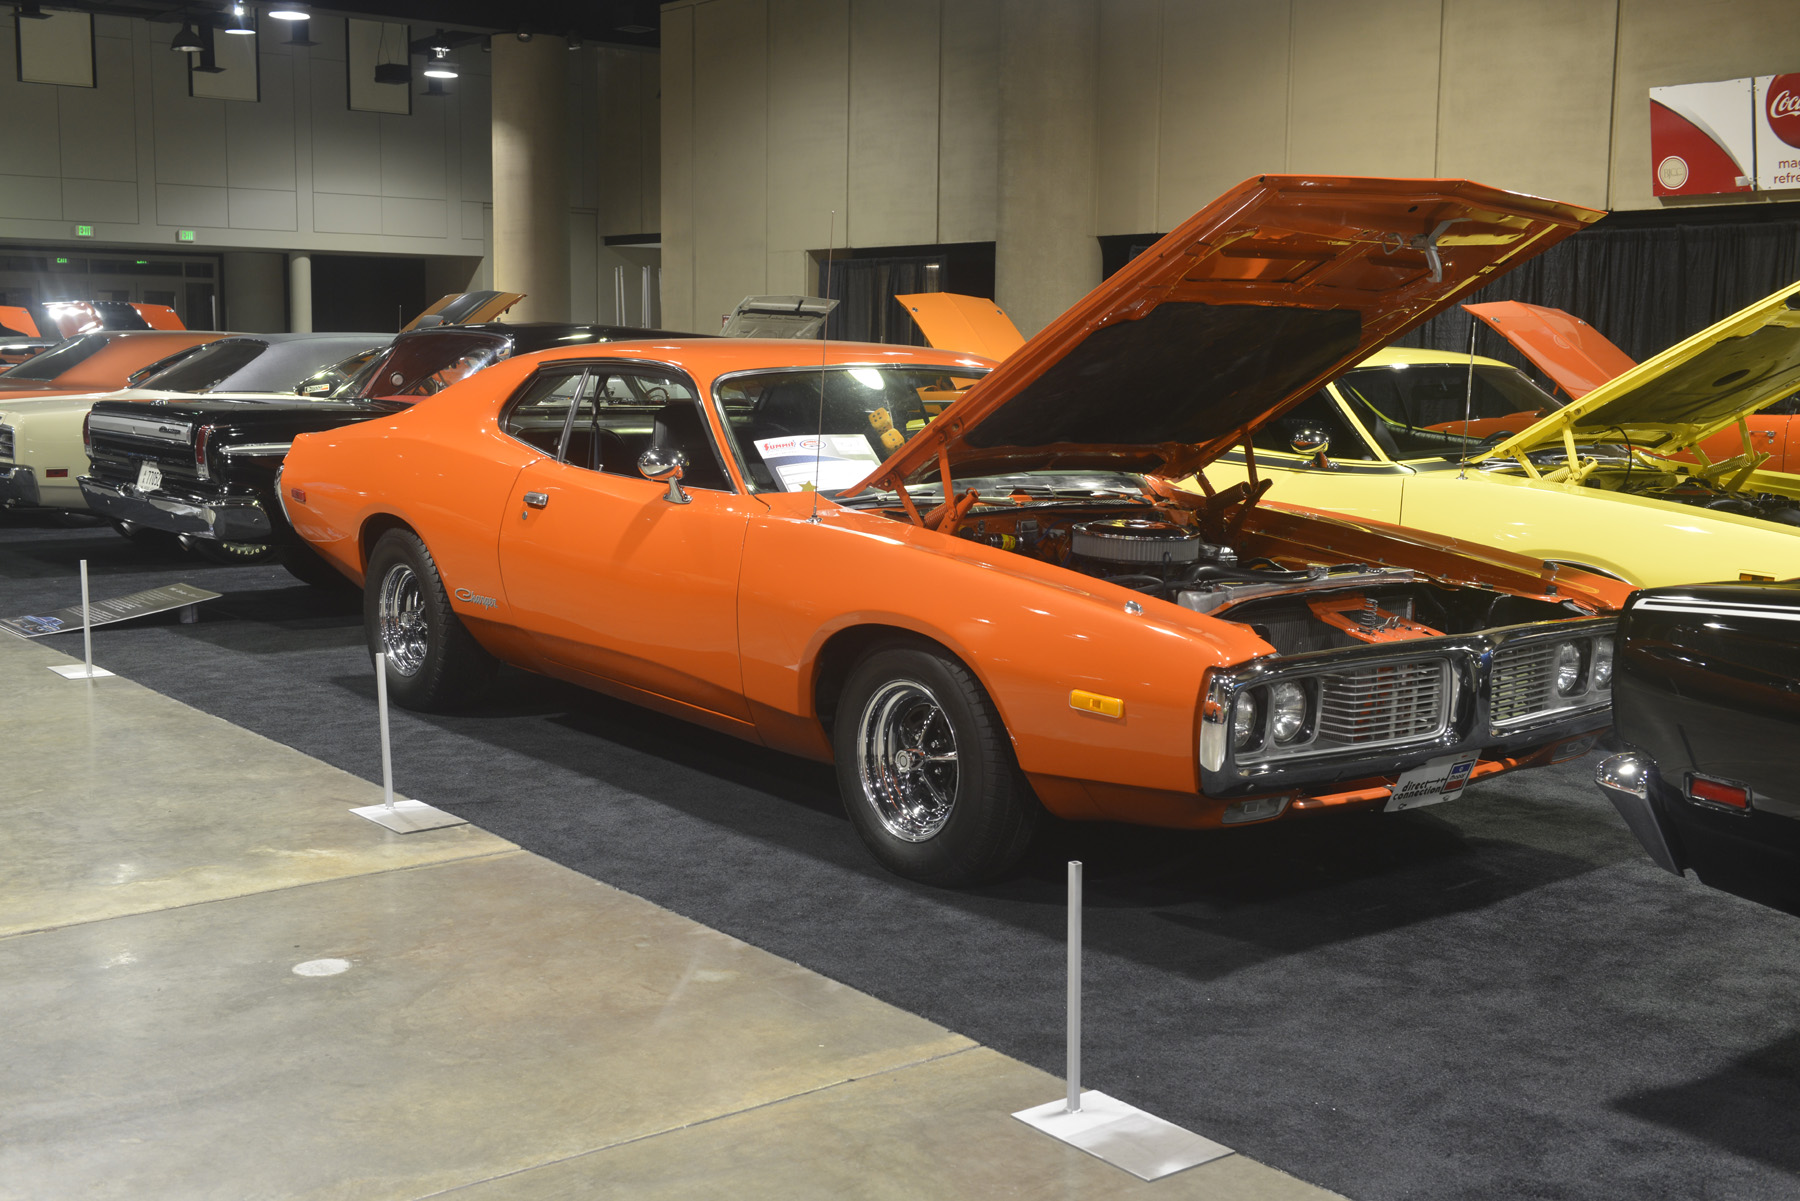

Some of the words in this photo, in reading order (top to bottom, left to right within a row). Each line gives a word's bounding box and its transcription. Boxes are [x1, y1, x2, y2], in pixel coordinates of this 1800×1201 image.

[79, 225, 91, 236] EXIT
[181, 230, 193, 241] EXIT
[1402, 780, 1429, 792] direct
[1393, 786, 1441, 800] connection
